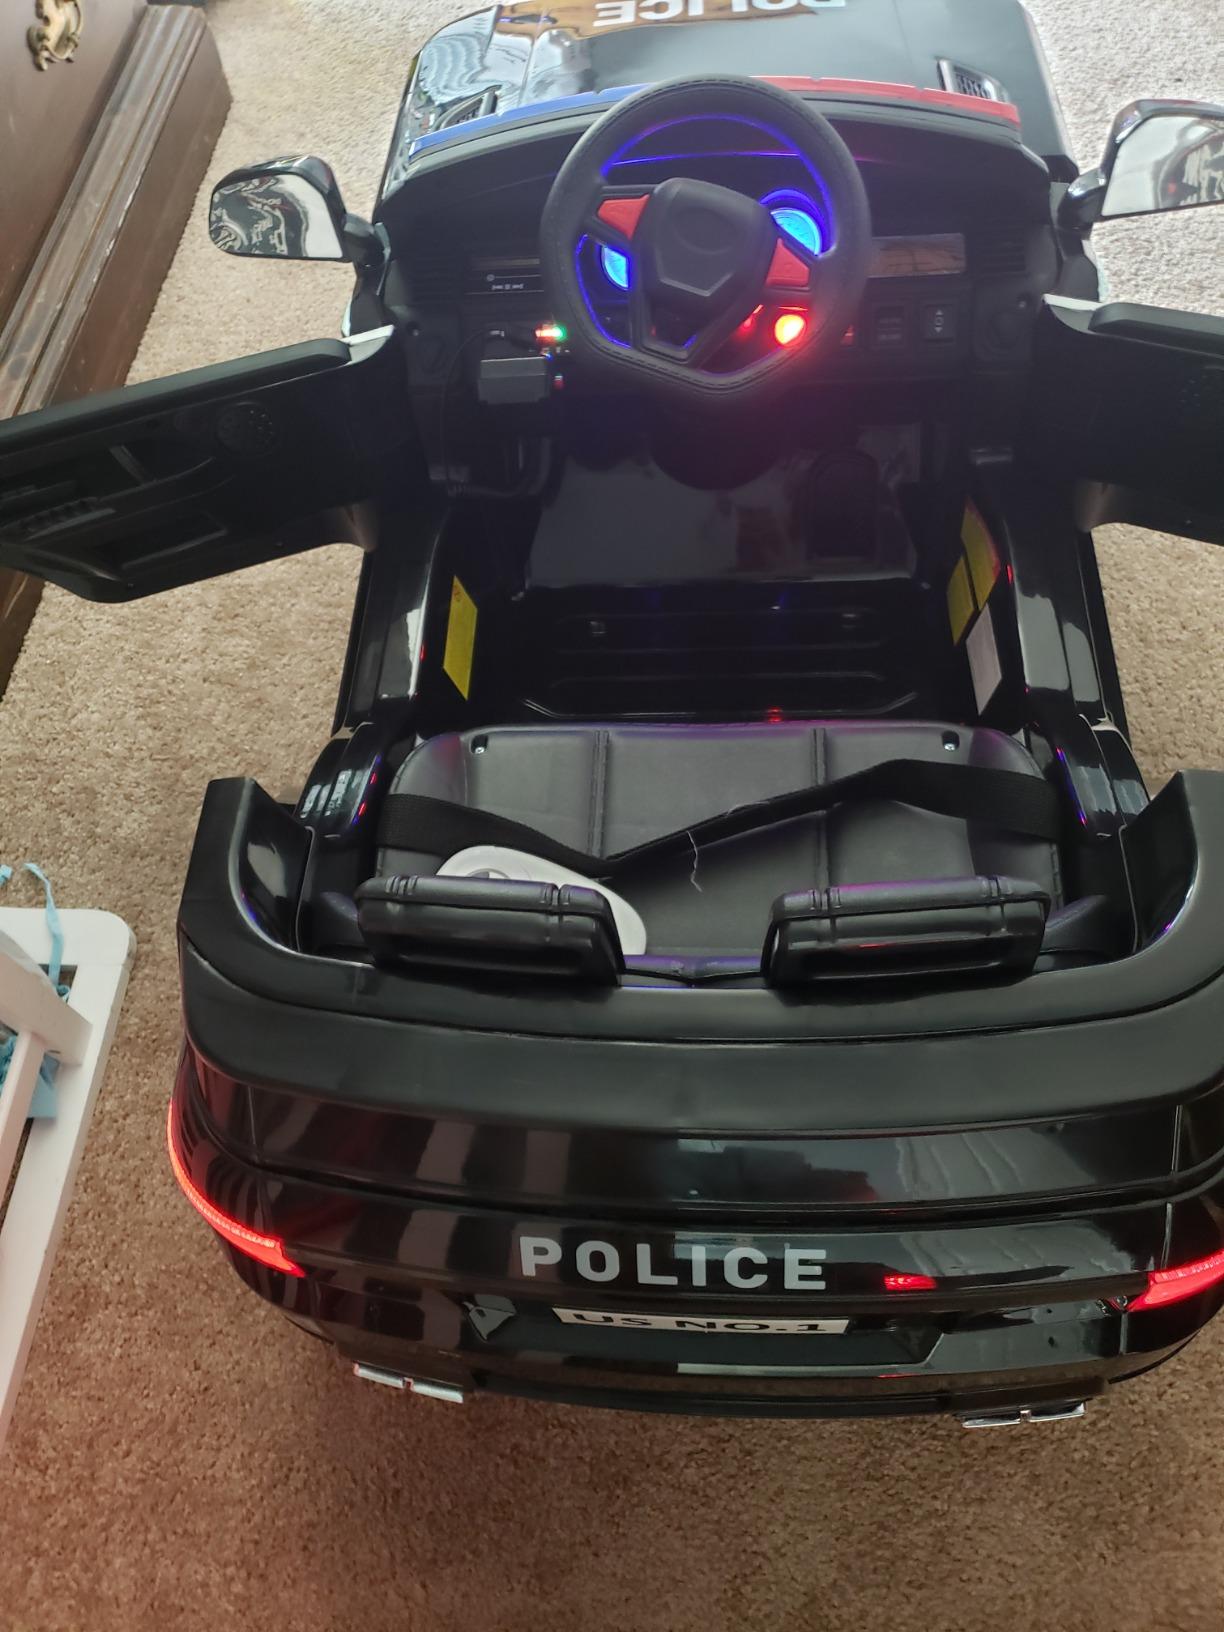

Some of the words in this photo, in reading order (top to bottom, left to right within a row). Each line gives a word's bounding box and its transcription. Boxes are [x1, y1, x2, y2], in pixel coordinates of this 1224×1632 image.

[519, 1236, 827, 1290] POLICE
[573, 1313, 652, 1326] US
[675, 1320, 826, 1332] NO.1
